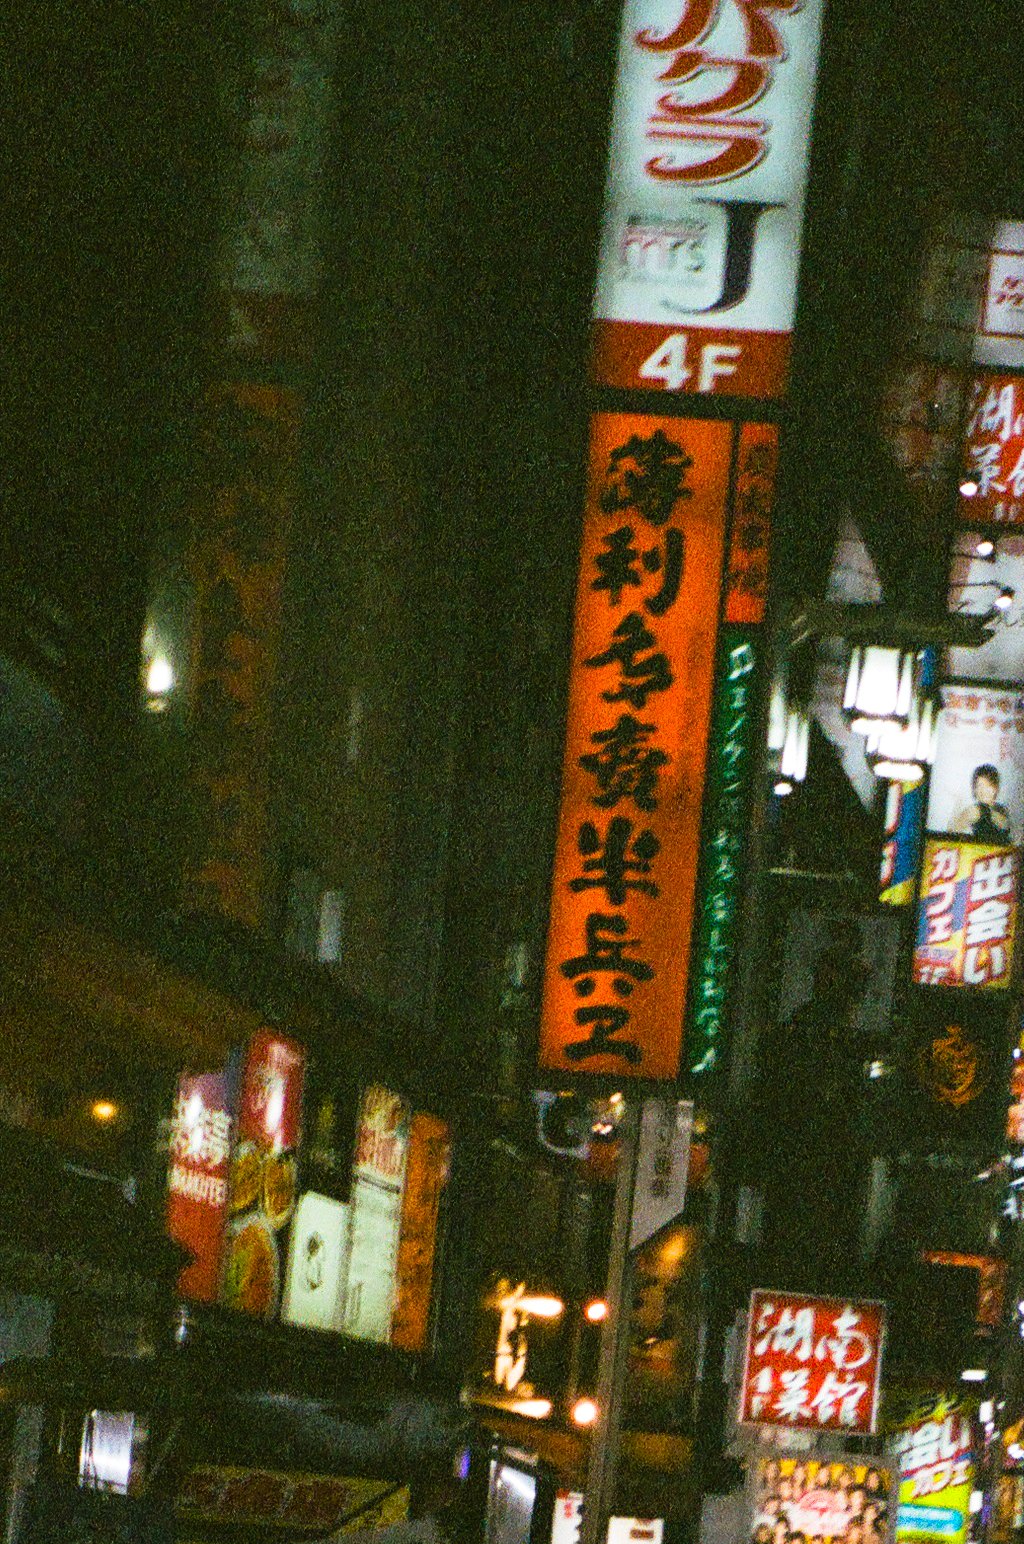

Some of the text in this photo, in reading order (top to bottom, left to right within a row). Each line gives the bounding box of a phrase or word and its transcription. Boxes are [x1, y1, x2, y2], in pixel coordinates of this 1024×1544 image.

[659, 197, 787, 315] J
[638, 332, 743, 393] 4F
[926, 848, 959, 945] カフェ
[962, 854, 1014, 985] 出会い
[753, 1301, 873, 1370] 湖南
